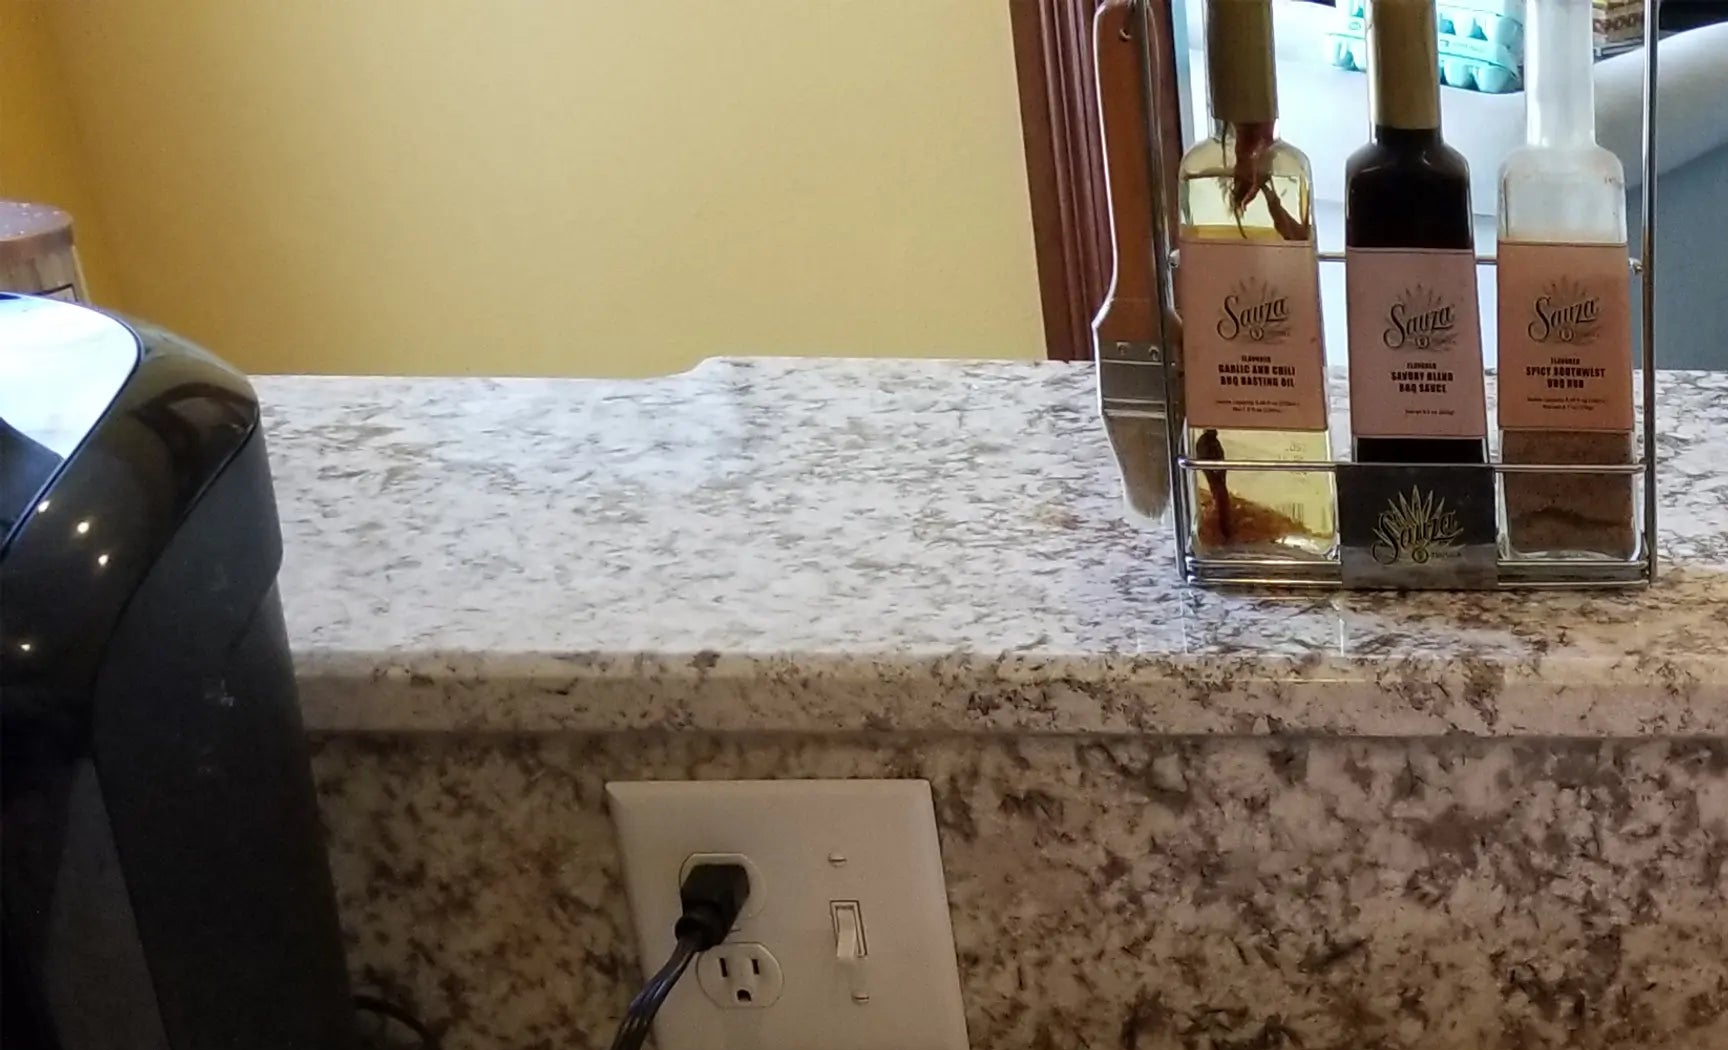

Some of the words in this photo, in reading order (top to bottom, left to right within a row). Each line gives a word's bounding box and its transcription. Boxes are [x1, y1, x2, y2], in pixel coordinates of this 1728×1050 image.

[1217, 295, 1289, 340] Sauza
[1527, 296, 1600, 342] Sauza
[1383, 304, 1455, 349] Sauza
[1218, 364, 1250, 373] GARLIC
[1252, 365, 1269, 374] AND
[1272, 366, 1295, 375] CHILI
[1526, 366, 1551, 376] SPICY
[1554, 367, 1606, 377] SOUTHWEST
[1220, 376, 1238, 386] BBQ
[1241, 377, 1278, 387] BASTING
[1281, 378, 1294, 387] OIL
[1391, 372, 1424, 381] SAVORY
[1399, 383, 1416, 393] BBQ
[1419, 384, 1446, 393] SAUCE
[1547, 379, 1565, 388] BBQ
[1371, 510, 1457, 564] Sauza
